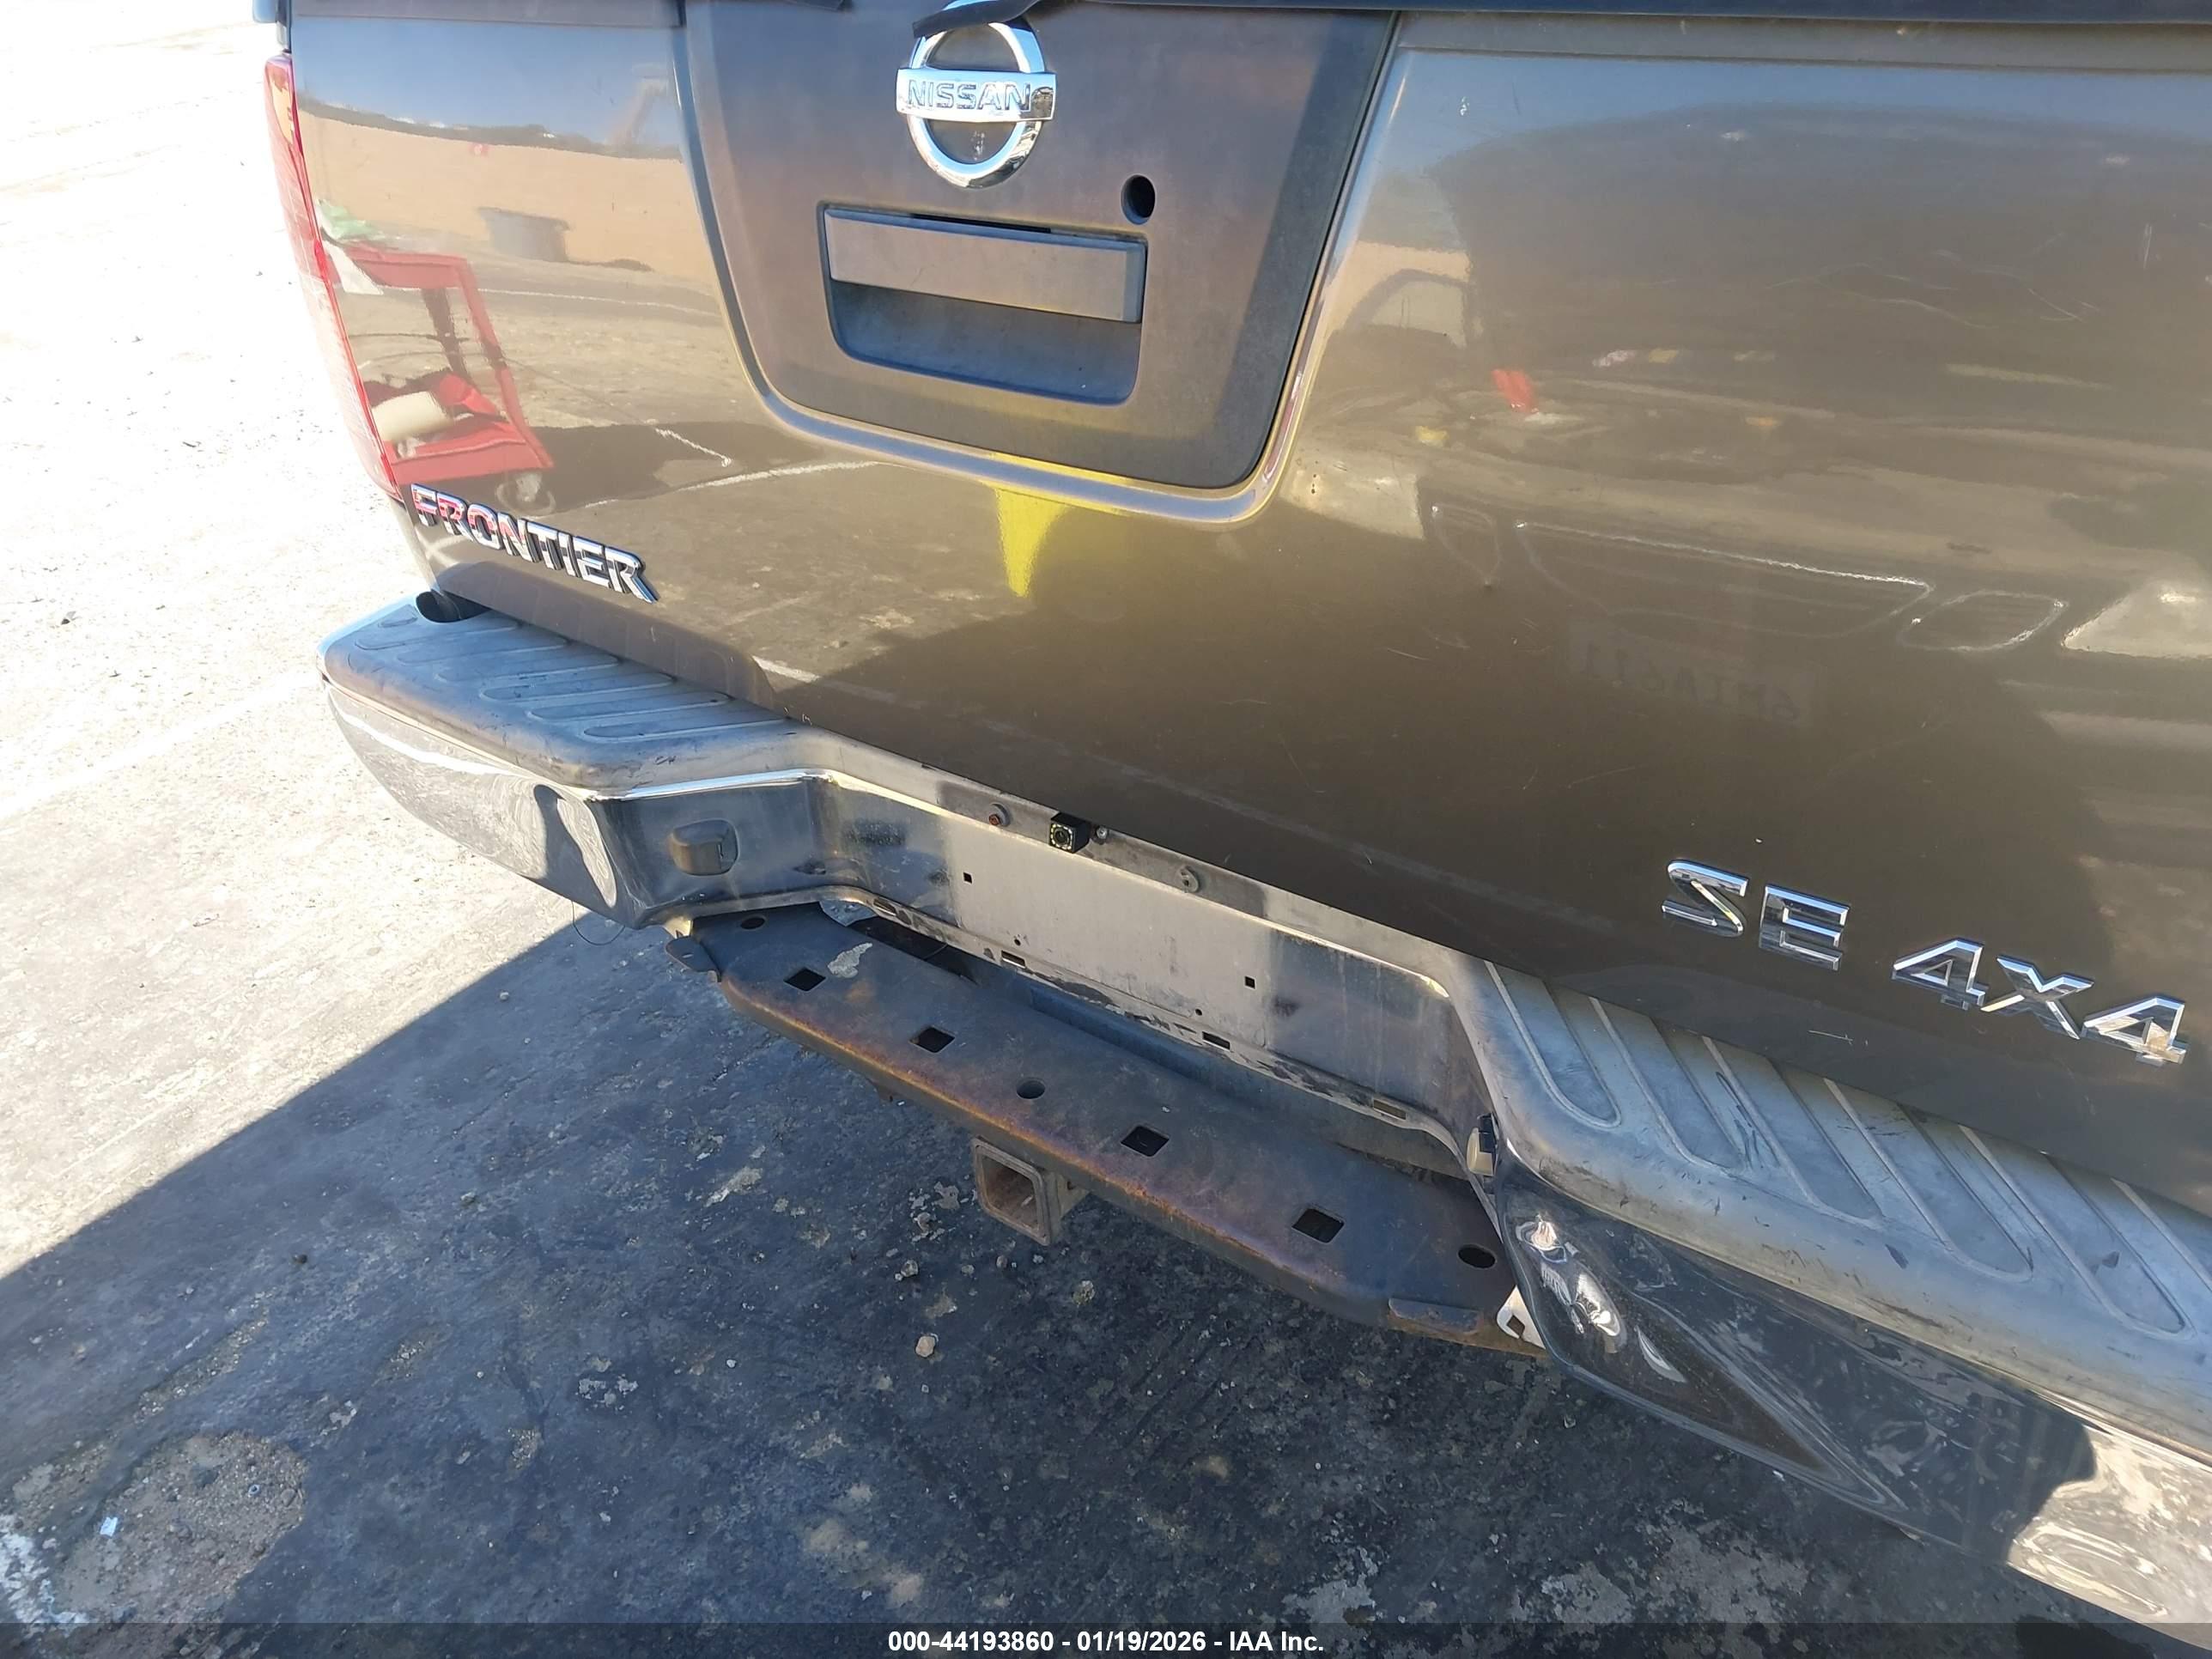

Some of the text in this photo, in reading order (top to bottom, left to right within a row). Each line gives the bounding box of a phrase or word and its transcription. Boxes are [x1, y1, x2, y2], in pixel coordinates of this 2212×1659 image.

[908, 79, 1031, 112] NISSAN
[410, 483, 659, 604] FRONTIER
[1662, 859, 1850, 971] SE
